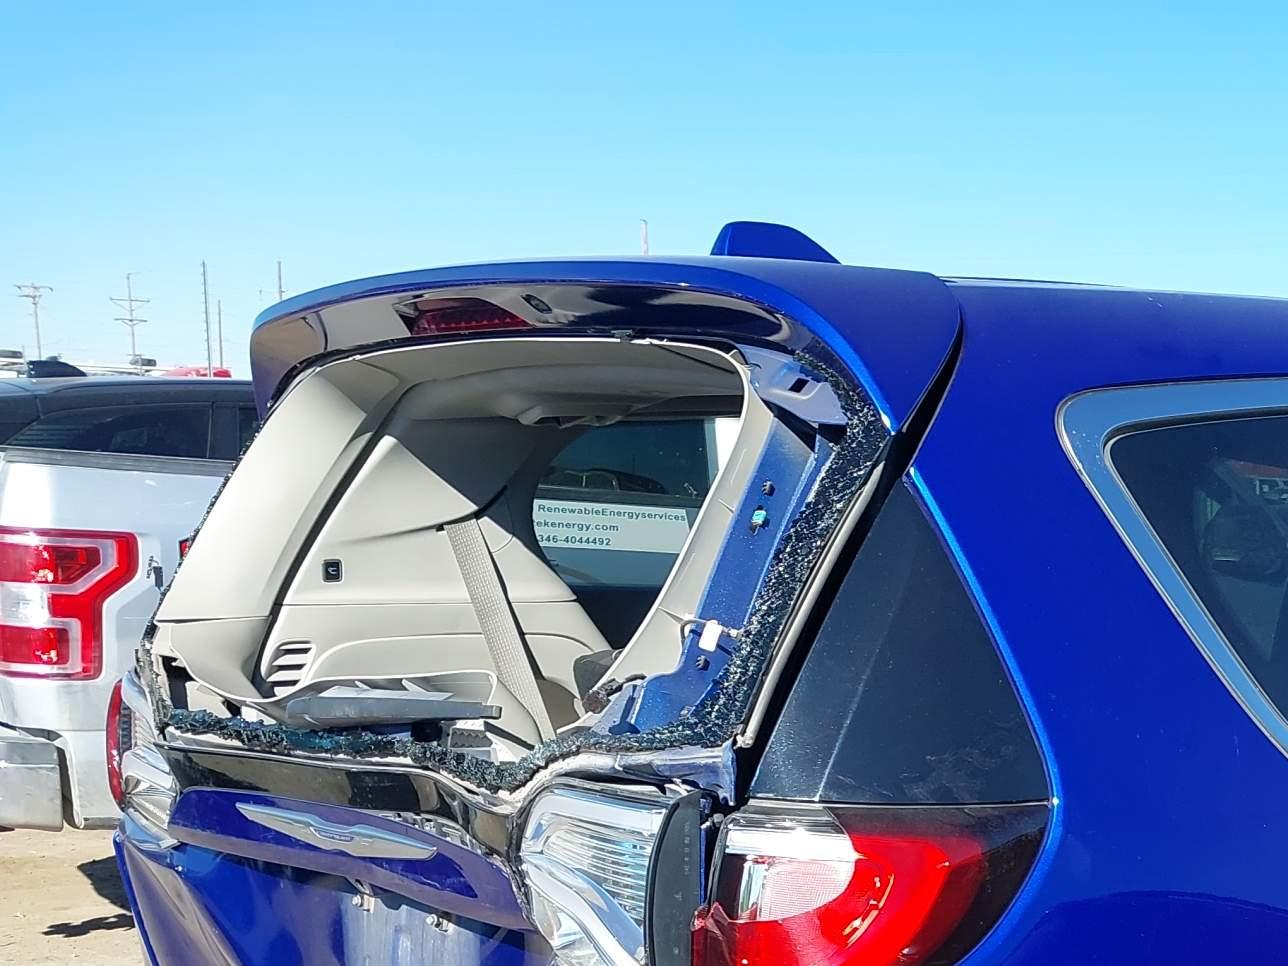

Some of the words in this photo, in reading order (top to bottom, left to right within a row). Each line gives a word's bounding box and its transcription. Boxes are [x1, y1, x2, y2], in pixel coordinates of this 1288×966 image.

[538, 504, 686, 521] RenewableEnergyservices
[534, 519, 619, 531] ekenergy.com
[538, 534, 611, 546] 346-4044492
